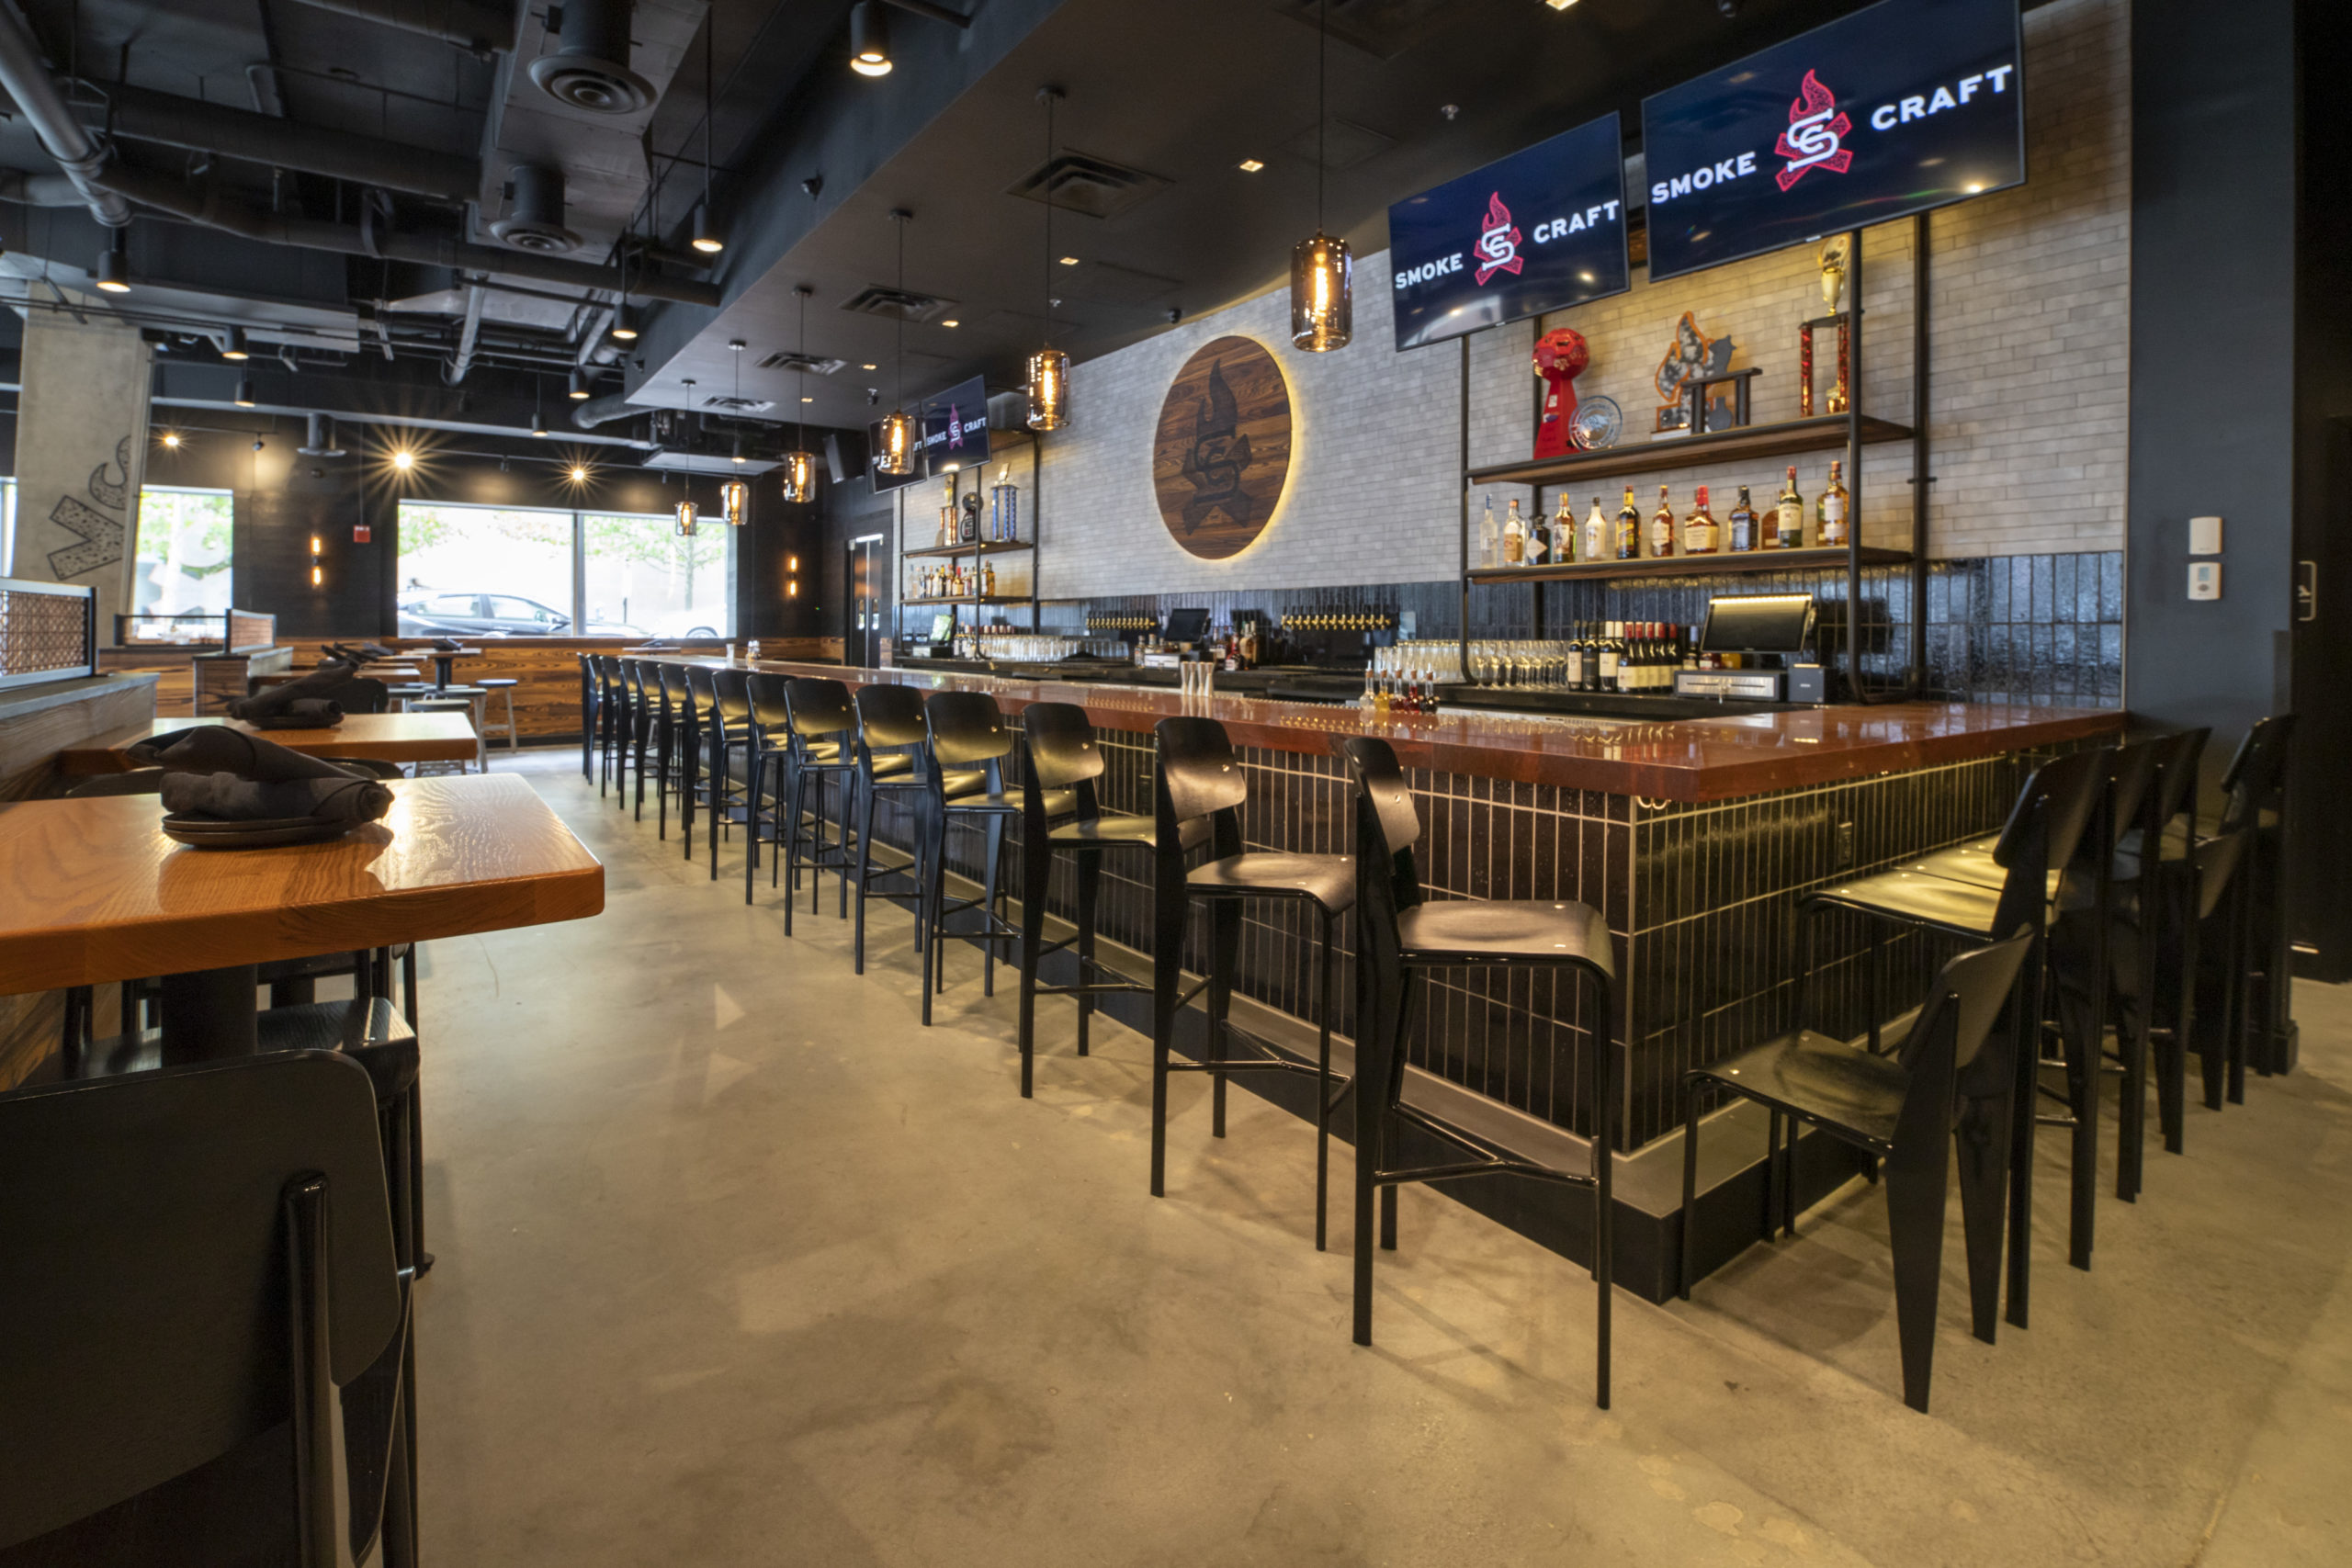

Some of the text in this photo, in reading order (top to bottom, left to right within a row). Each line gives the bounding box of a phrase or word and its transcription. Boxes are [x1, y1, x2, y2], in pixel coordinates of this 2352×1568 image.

[1652, 152, 1757, 204] SMOKE
[1871, 64, 2013, 131] CRAFT
[1395, 253, 1464, 289] SMOKE
[1533, 199, 1620, 244] CRAFT
[926, 432, 946, 446] SMOKE
[964, 417, 986, 433] CRAFT
